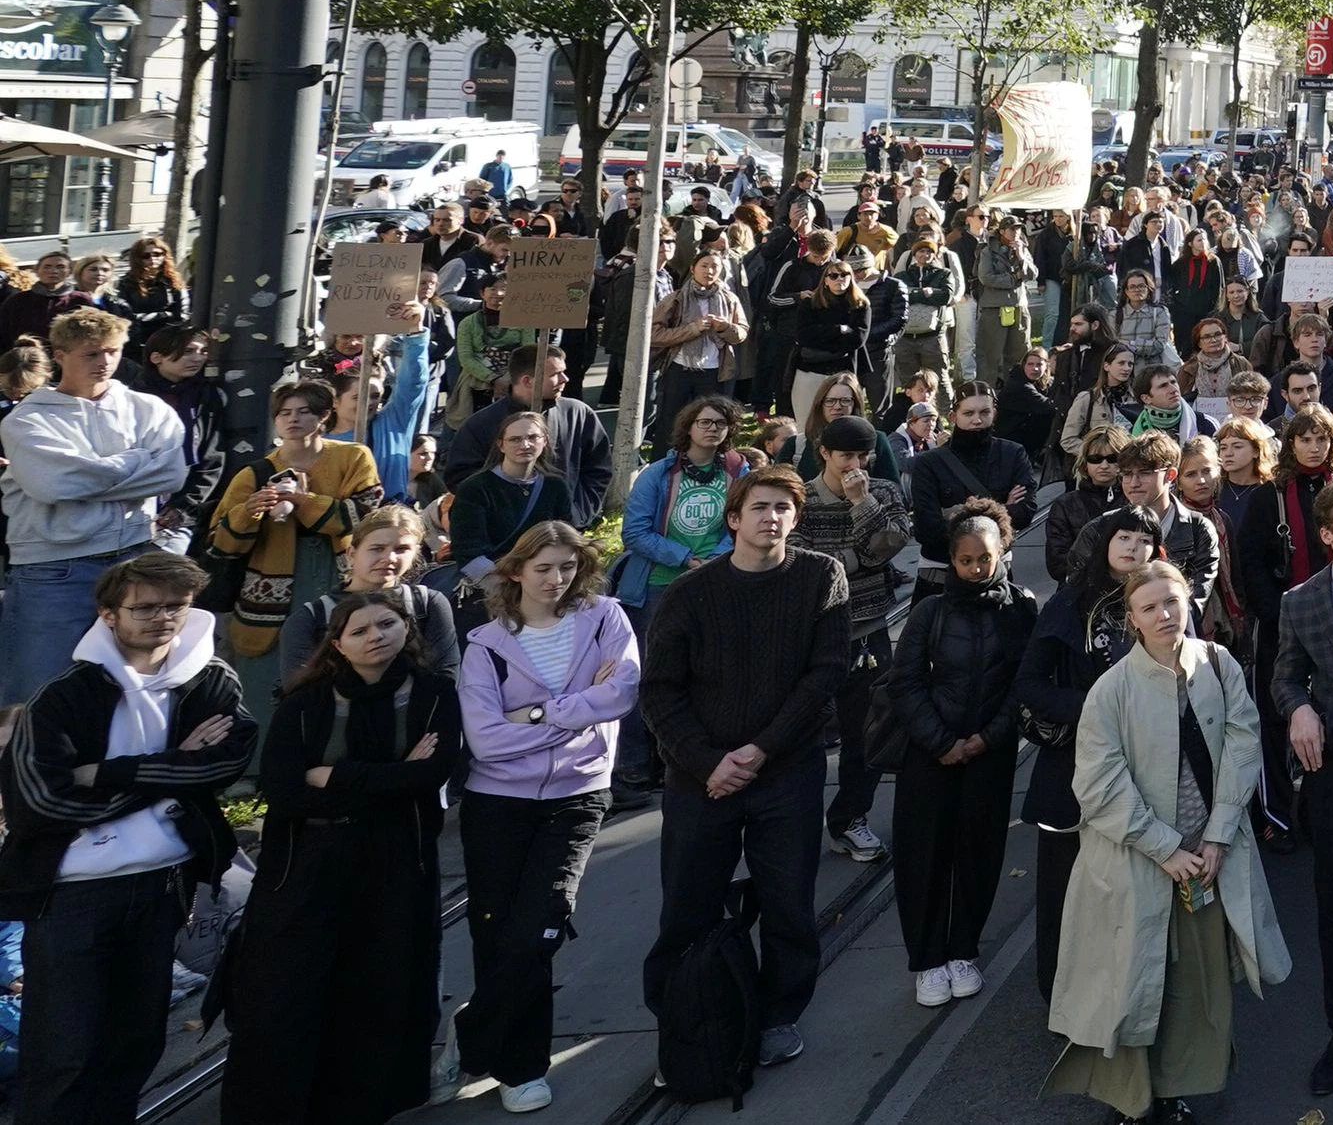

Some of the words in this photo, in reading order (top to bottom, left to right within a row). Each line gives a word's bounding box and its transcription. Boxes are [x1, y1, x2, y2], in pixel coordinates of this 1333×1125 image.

[0, 33, 87, 61] scobar
[337, 252, 408, 269] BILDUNG
[513, 250, 566, 268] HIRN
[331, 283, 402, 302] RÜSTUNG
[685, 503, 716, 519] BOKU
